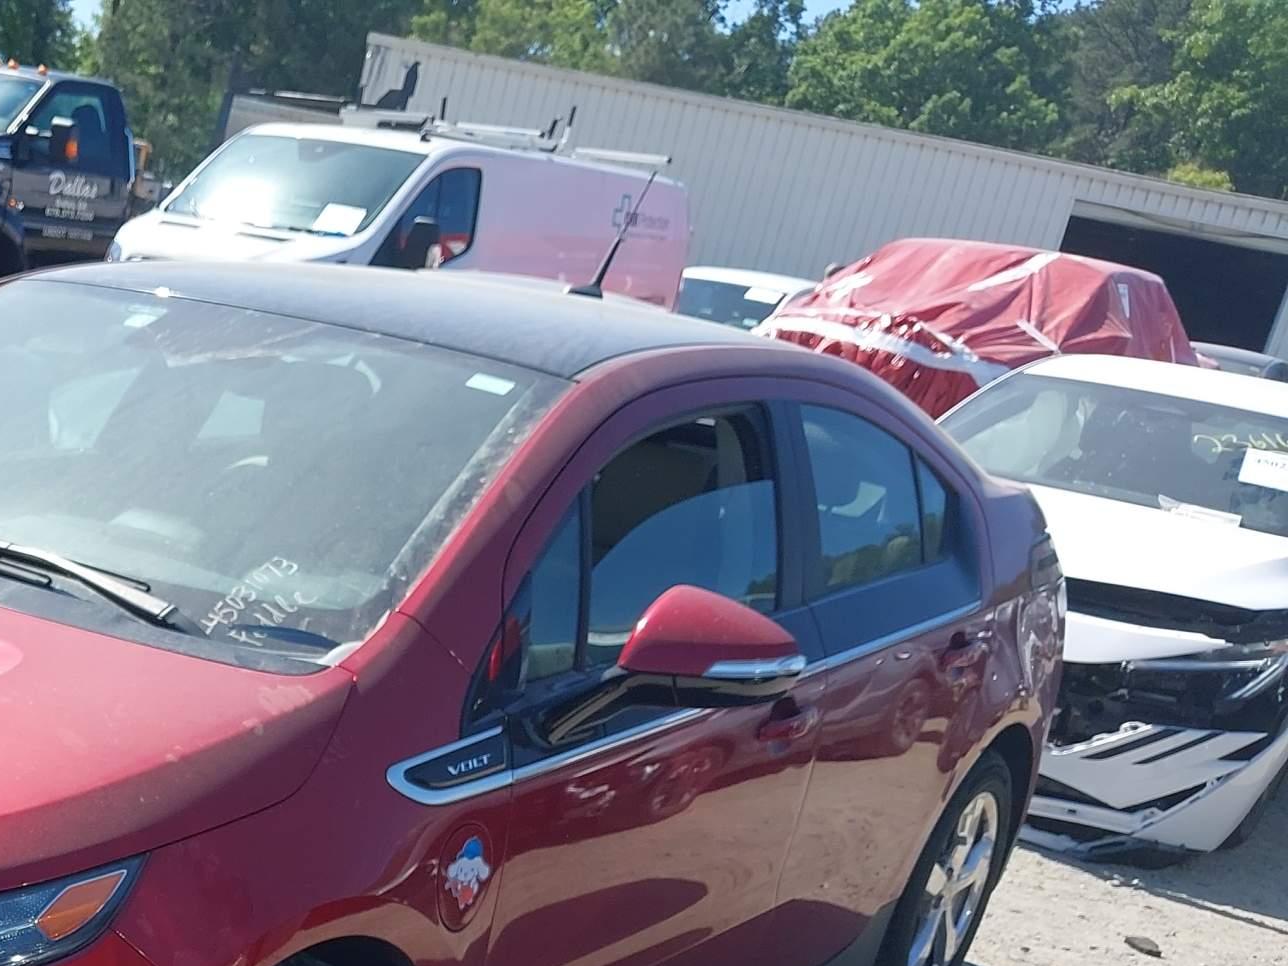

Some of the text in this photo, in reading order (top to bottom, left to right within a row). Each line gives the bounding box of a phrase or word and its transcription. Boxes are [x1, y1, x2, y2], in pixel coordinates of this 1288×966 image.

[49, 170, 98, 199] Dallas
[200, 555, 299, 635] 45031073
[447, 753, 491, 776] VOLT
